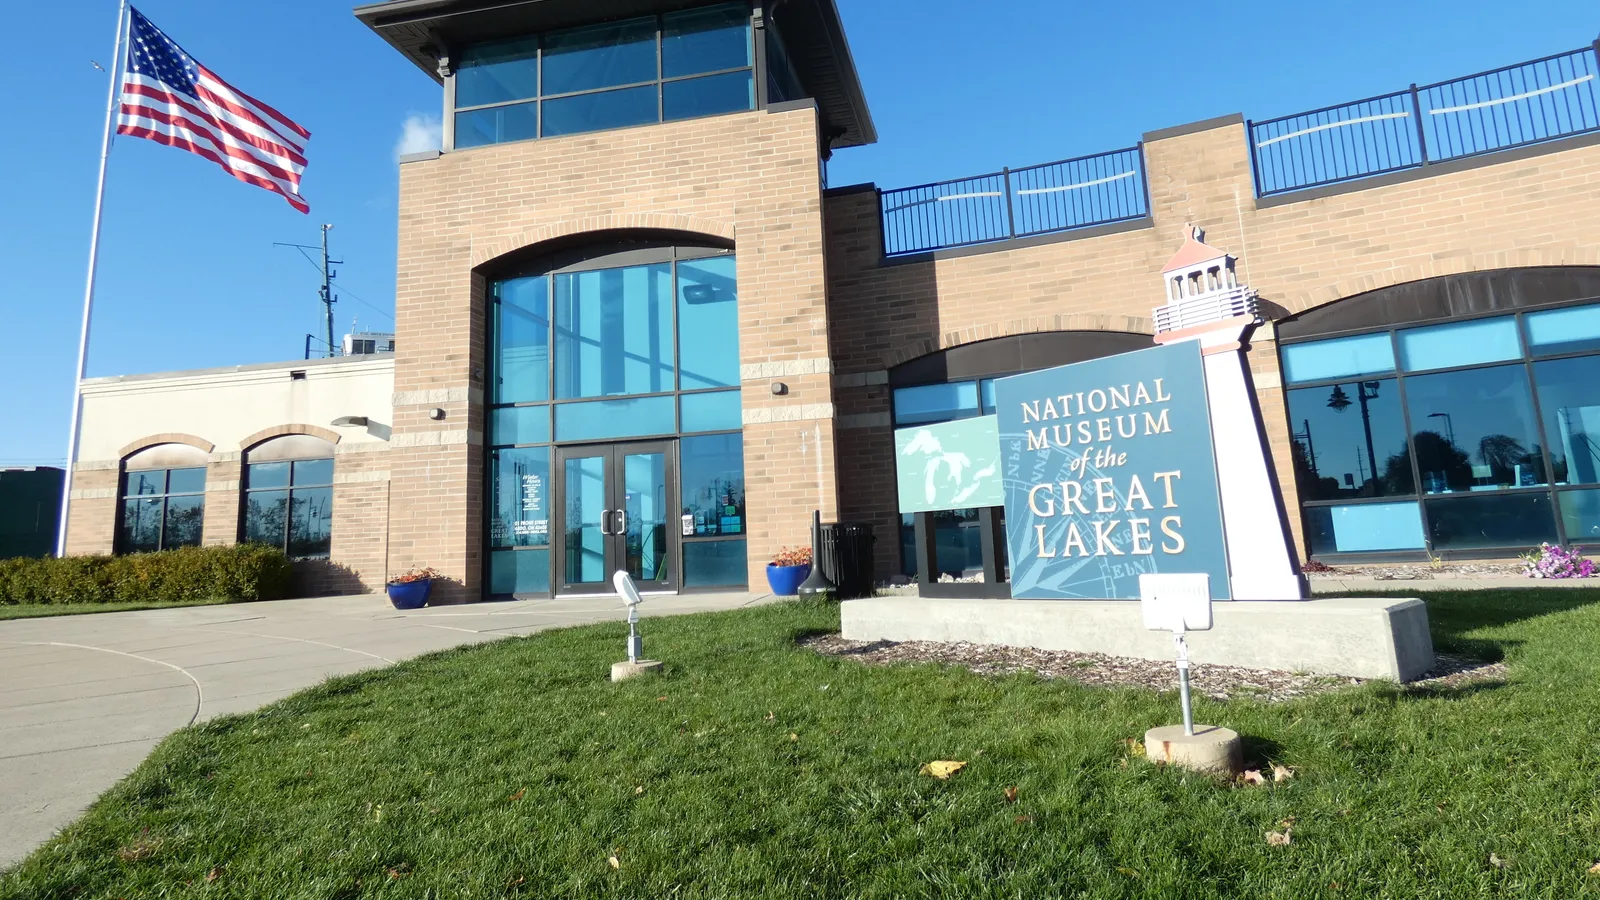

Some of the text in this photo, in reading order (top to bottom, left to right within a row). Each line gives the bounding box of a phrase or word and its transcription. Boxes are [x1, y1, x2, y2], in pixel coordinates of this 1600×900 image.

[1021, 378, 1171, 423] NATIONAL
[1026, 408, 1172, 452] MUSEUM
[1070, 445, 1128, 479] of the
[1028, 470, 1181, 518] GREAT
[1034, 515, 1186, 558] LAKES
